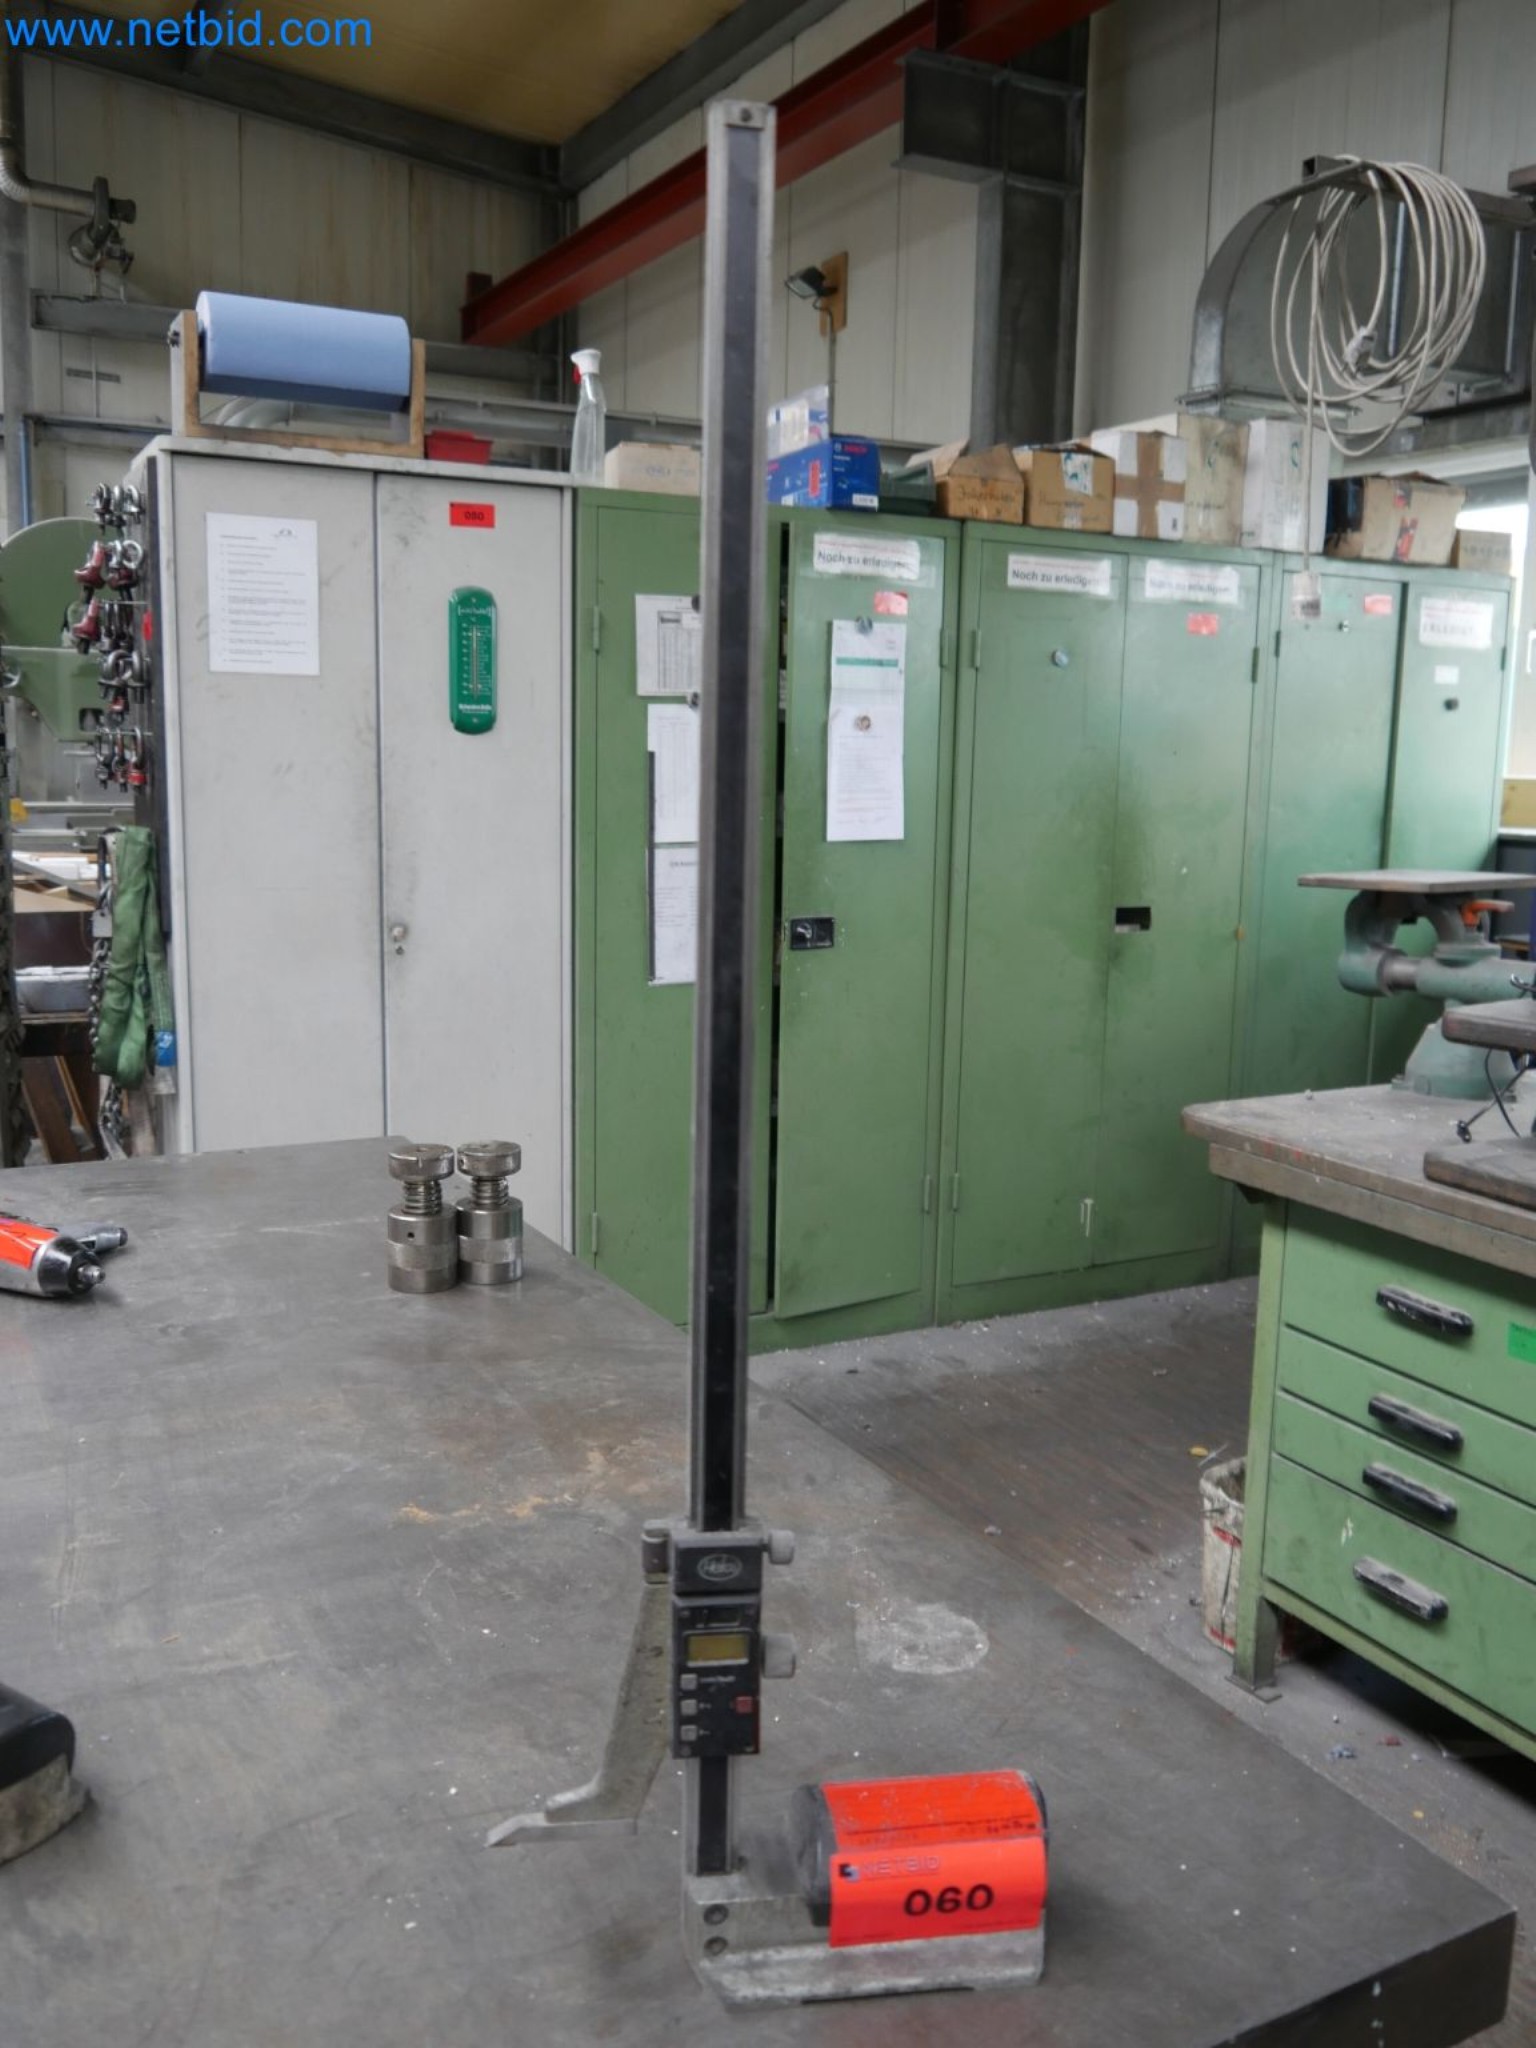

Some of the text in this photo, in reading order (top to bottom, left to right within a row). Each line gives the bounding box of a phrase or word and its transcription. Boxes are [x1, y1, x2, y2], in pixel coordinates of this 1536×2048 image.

[1012, 569, 1038, 581] Noch
[1041, 573, 1053, 583] zu
[904, 1883, 994, 1917] 060
